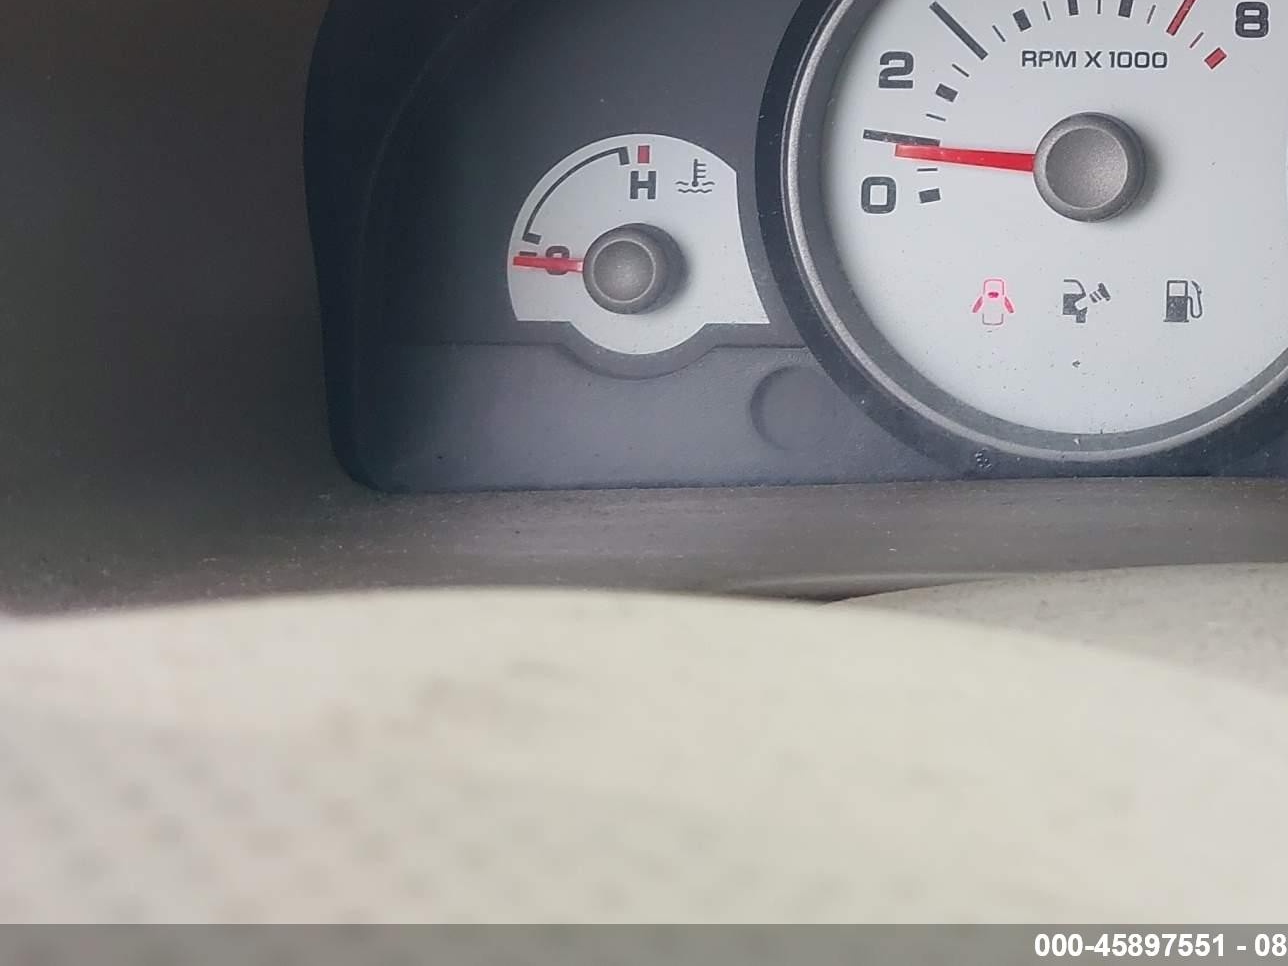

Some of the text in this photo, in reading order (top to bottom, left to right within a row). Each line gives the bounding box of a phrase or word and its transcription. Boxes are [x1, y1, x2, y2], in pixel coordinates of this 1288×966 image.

[1235, 2, 1269, 38] 8
[879, 52, 913, 88] 2
[1022, 51, 1167, 68] RPM X 1000
[630, 171, 656, 199] H
[861, 177, 896, 214] 0
